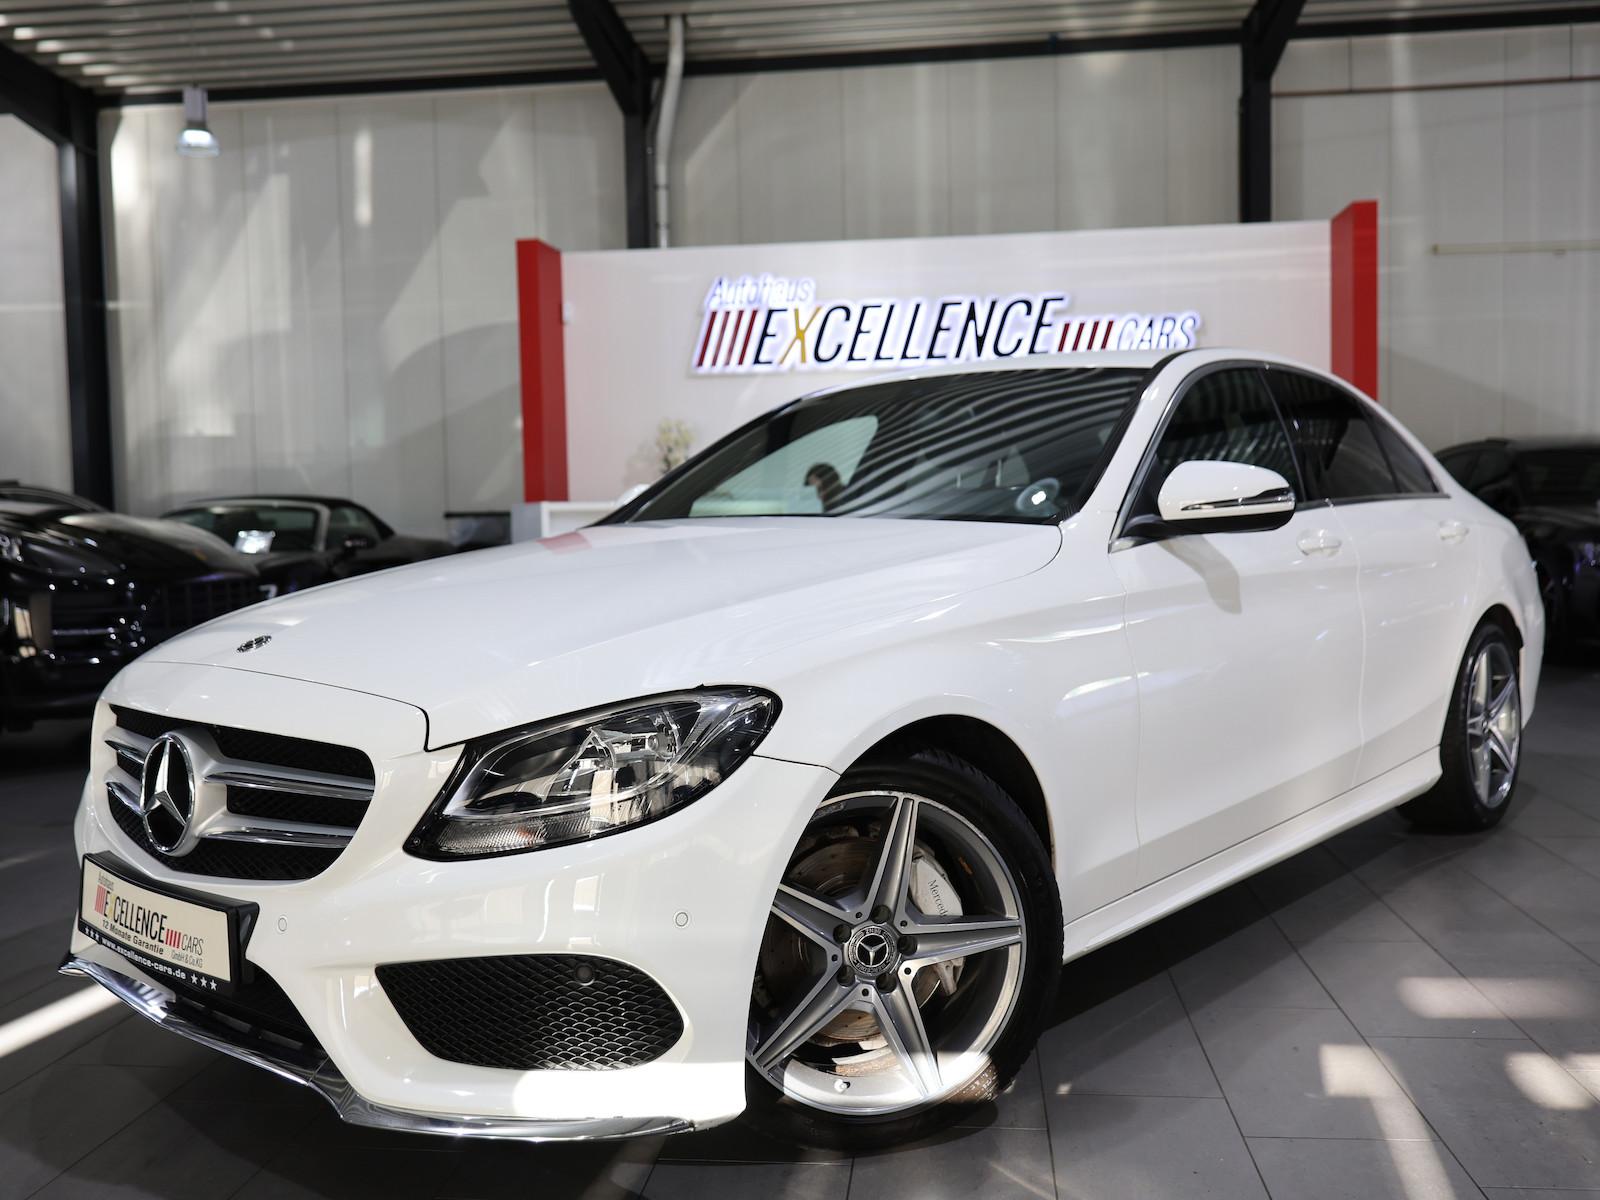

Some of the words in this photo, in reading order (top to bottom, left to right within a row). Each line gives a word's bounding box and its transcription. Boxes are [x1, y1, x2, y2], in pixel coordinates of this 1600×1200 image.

[753, 297, 1065, 365] EXCELLENCE
[1117, 315, 1197, 351] CARS
[104, 890, 168, 943] EXCELLENCE
[181, 933, 204, 956] CARS
[927, 879, 948, 917] Merced
[102, 919, 109, 930] 12
[109, 922, 132, 942] Monate
[133, 935, 164, 955] Garantie
